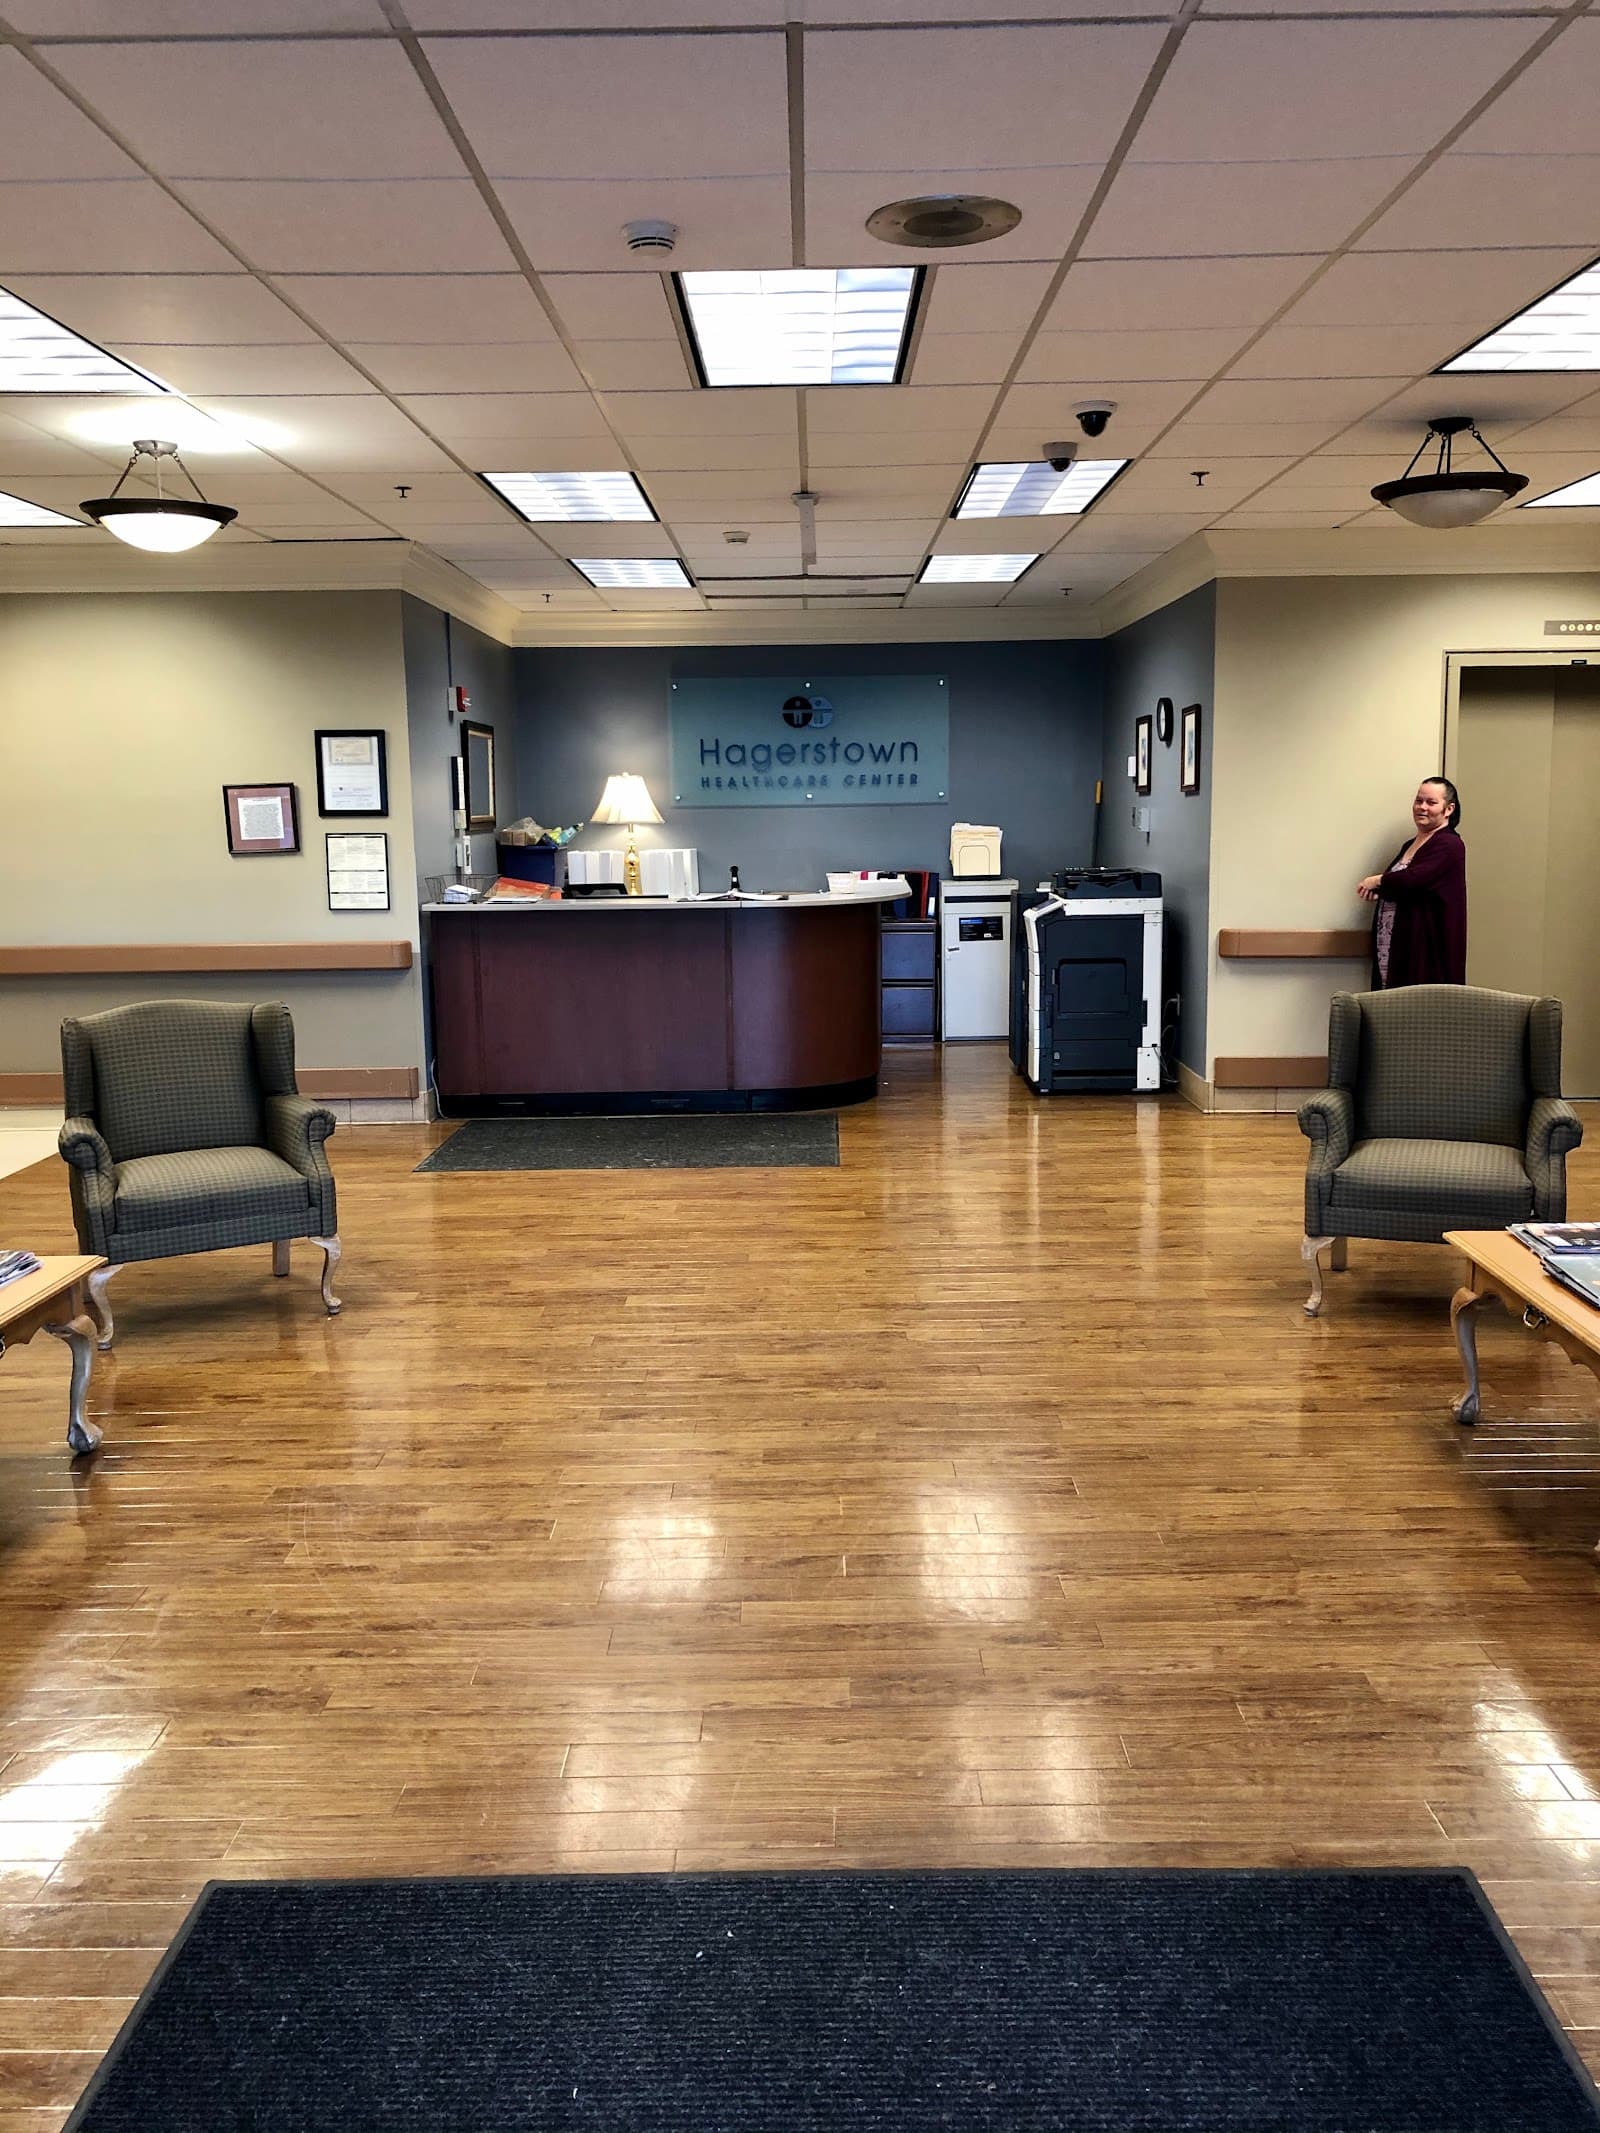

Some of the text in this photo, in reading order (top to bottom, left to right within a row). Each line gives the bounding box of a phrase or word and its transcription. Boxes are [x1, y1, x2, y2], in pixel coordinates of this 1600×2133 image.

[700, 737, 918, 771] Hagerstown
[701, 773, 918, 788] HEALTHCARE CENTER
